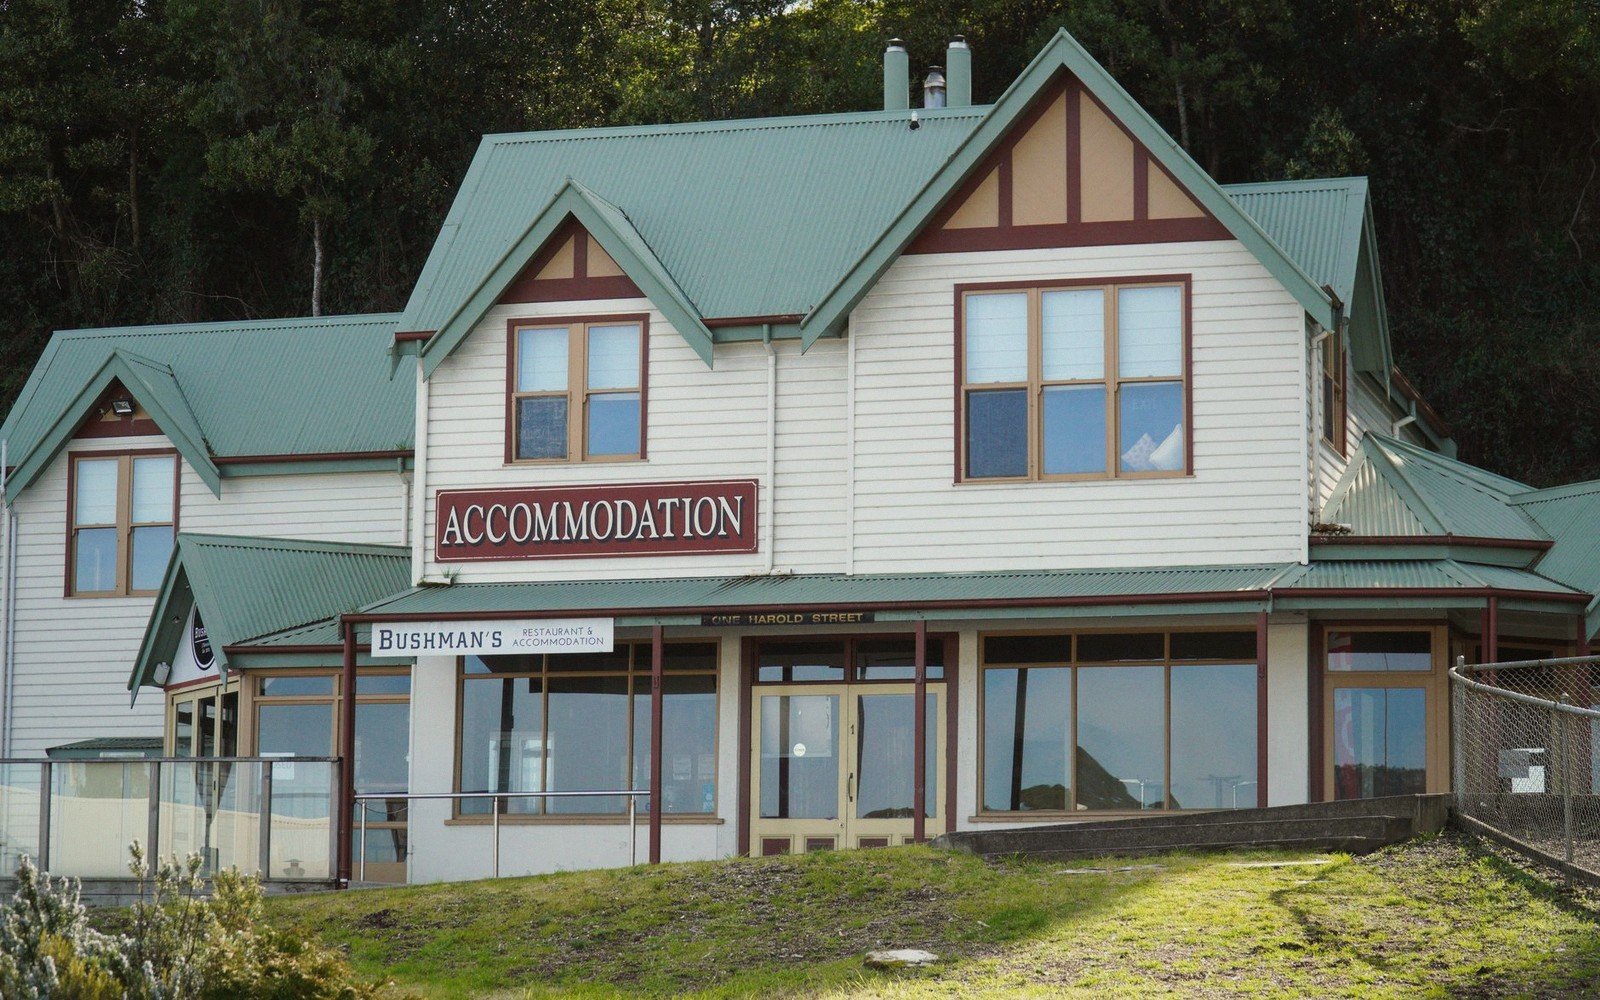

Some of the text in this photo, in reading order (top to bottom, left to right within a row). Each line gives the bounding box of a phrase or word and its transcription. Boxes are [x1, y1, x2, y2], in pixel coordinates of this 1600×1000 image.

[441, 496, 744, 545] ACCOMMODATION
[712, 612, 863, 625] ONE HAROLD STREET
[522, 626, 593, 637] RESTAURANT &
[379, 629, 502, 650] BUSHMAN'S
[512, 637, 604, 647] ACCOMMODATION
